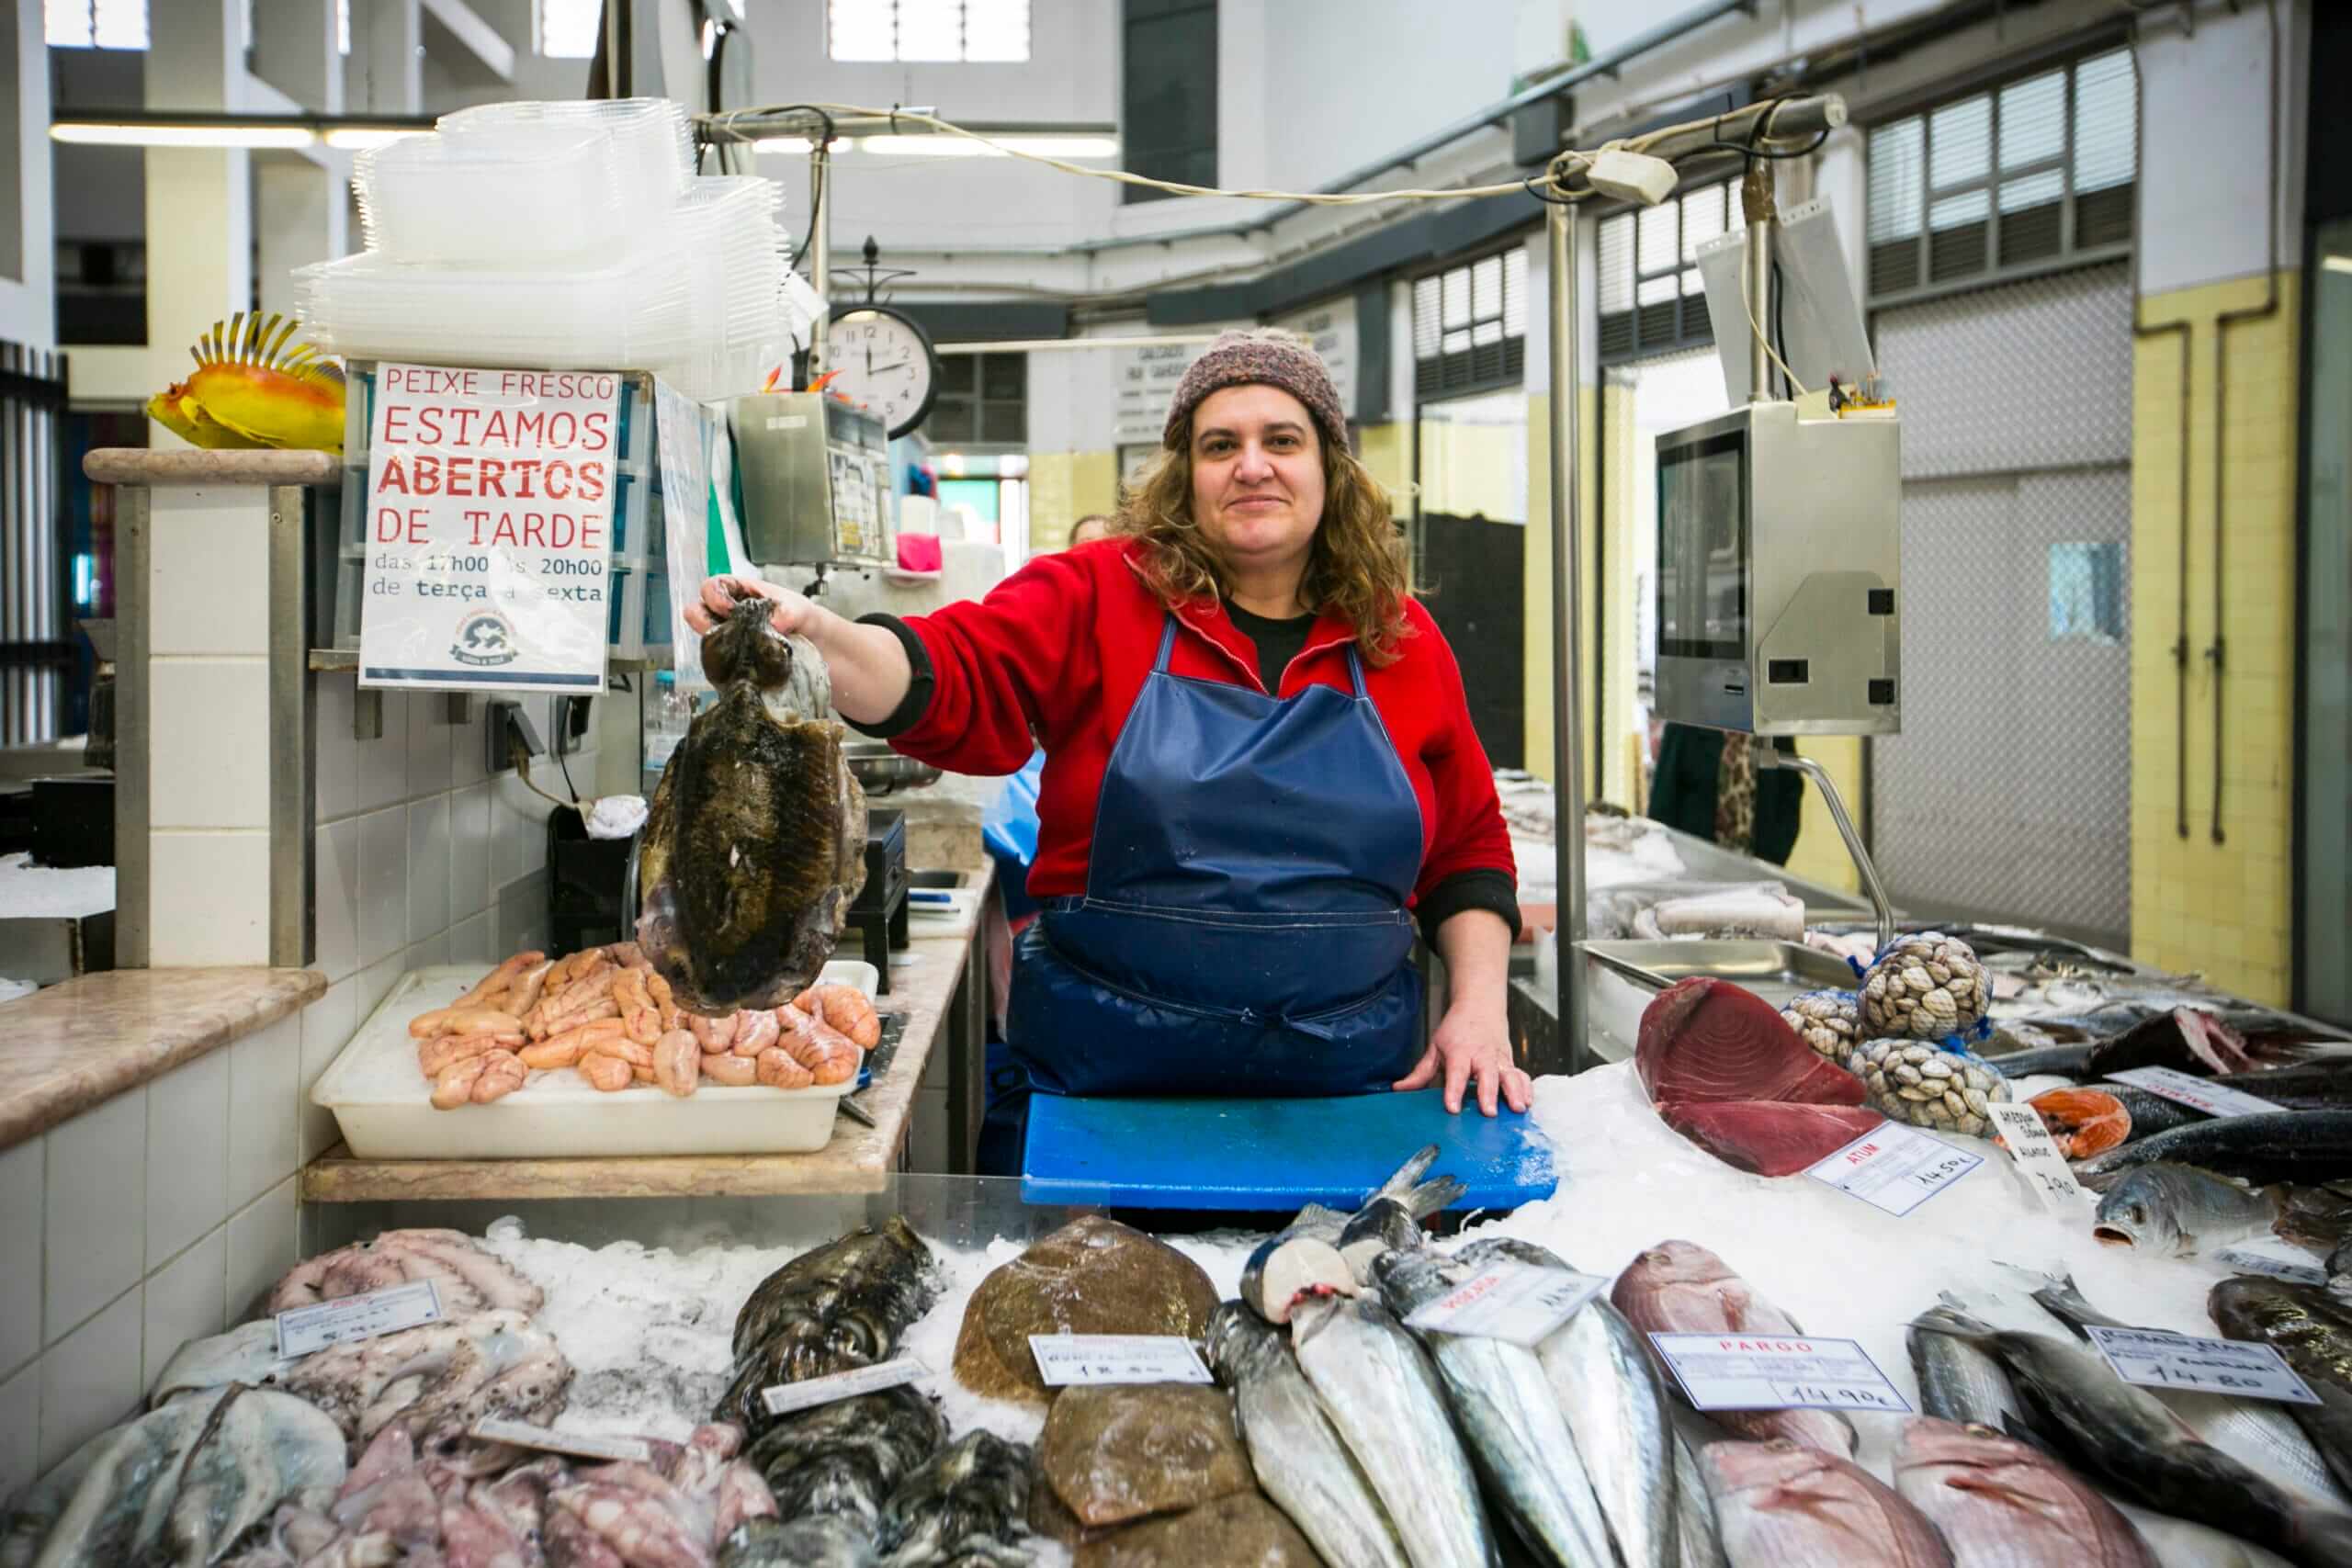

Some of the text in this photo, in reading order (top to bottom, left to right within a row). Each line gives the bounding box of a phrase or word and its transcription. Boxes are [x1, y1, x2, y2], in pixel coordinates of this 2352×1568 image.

[387, 368, 614, 400] PEIXE FRESCO
[384, 406, 608, 451] ESTAMOS
[378, 455, 605, 502] ABERTOS
[378, 508, 604, 549] DE TARDE
[375, 553, 413, 570] das
[541, 558, 603, 575] 20h00
[372, 577, 401, 595] de
[416, 580, 488, 603] terça
[1845, 1143, 1882, 1166] ATUM
[1719, 1340, 1814, 1353] PARGO
